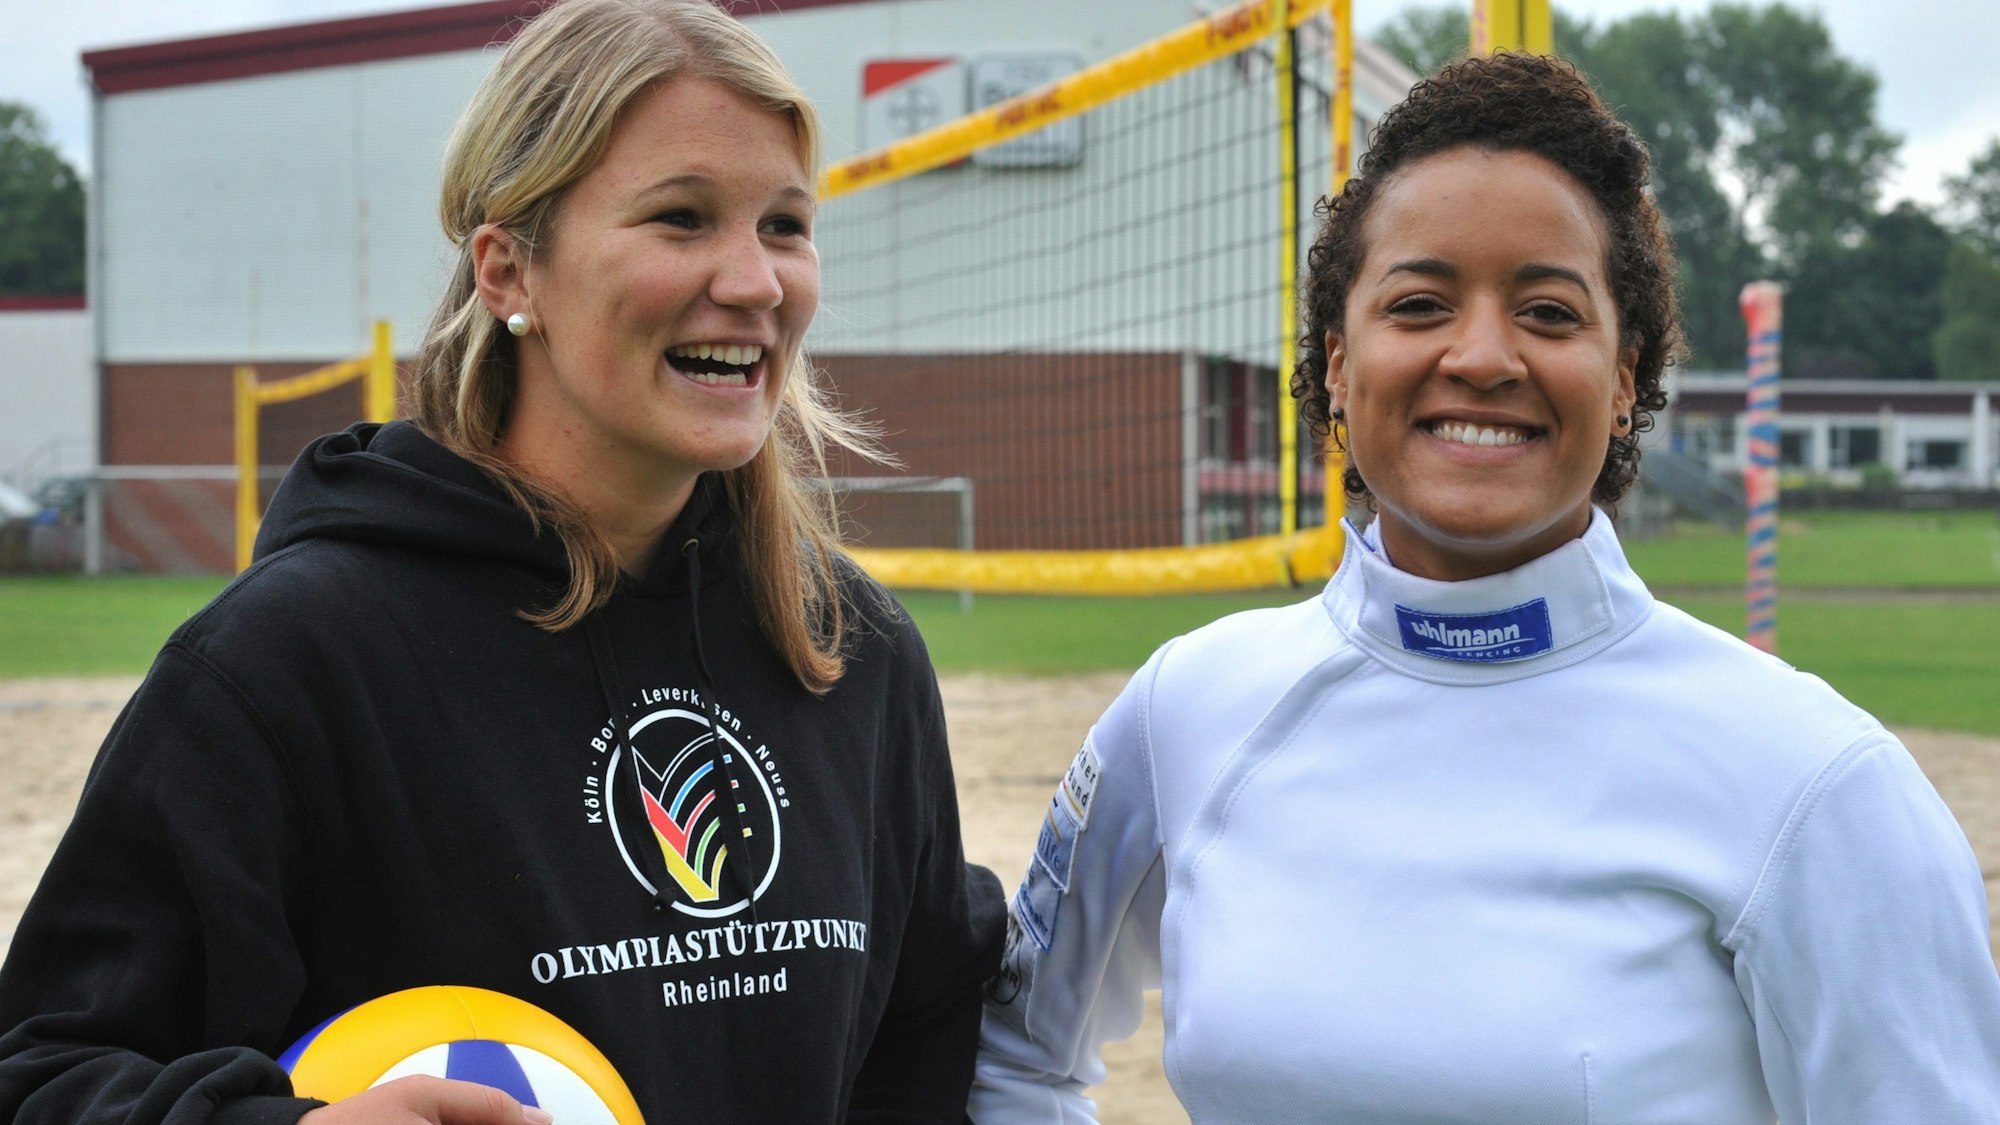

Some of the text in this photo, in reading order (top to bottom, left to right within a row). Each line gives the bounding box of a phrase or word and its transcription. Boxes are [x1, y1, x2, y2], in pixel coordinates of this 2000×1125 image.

[1410, 619, 1521, 648] uhlmann
[590, 713, 629, 754] Bo
[755, 744, 790, 808] Neuss
[583, 775, 603, 824] Köln
[530, 918, 867, 985] OLYMPIASTÜTZPUNKT
[663, 967, 788, 1008] Rheinland
